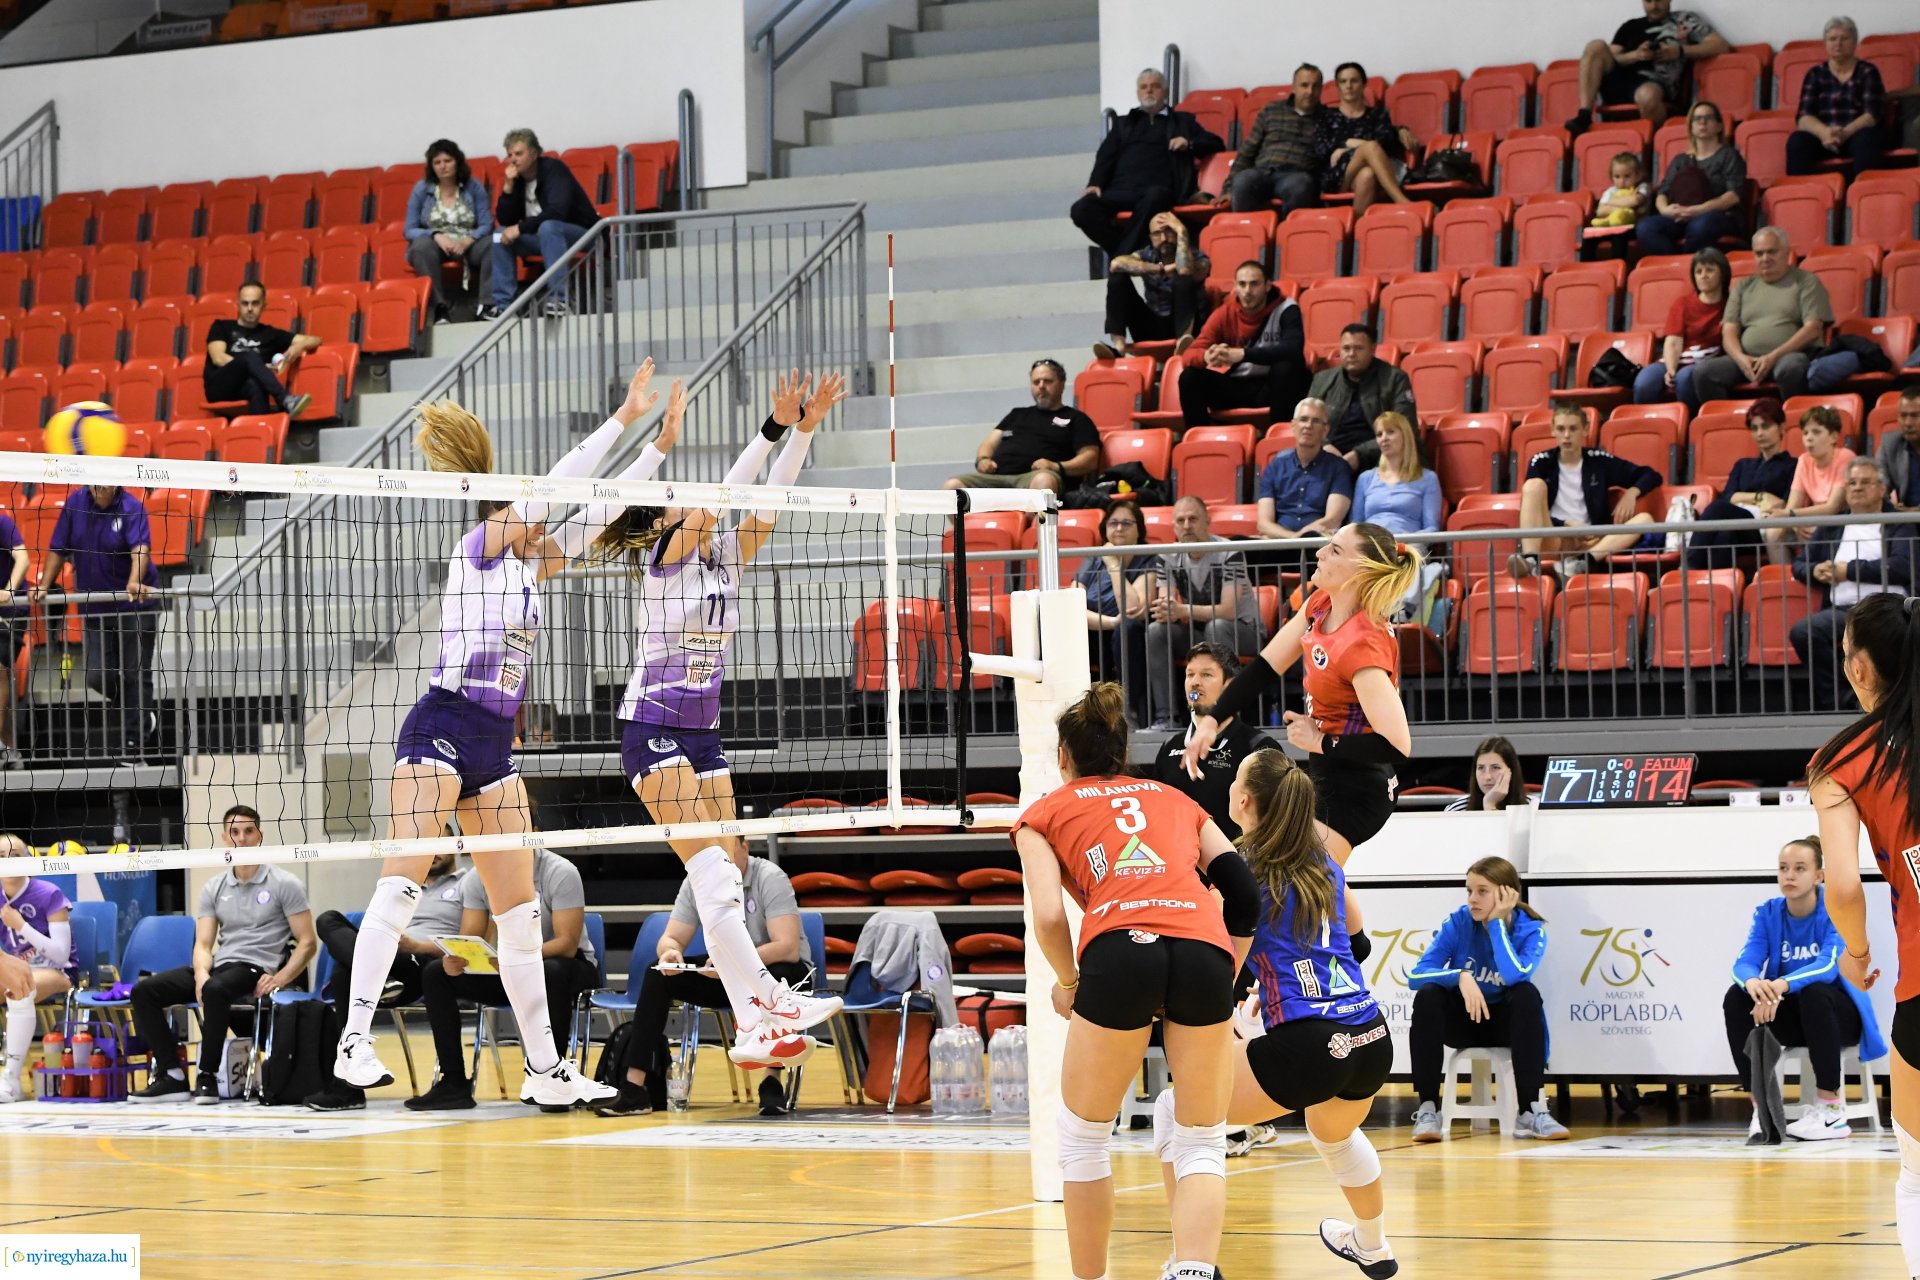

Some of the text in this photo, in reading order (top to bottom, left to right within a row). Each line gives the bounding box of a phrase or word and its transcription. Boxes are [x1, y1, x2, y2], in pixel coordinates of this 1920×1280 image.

[136, 464, 170, 480] FATUM
[378, 475, 408, 490] FATUM
[593, 483, 620, 499] FATUM
[786, 491, 811, 505] FATUM
[1549, 759, 1576, 771] UTE
[1644, 757, 1693, 770] FATUM
[1628, 771, 1637, 780] 0
[1075, 782, 1163, 799] MILANOVA
[1559, 773, 1582, 802] 7
[1644, 771, 1685, 801] 14
[1610, 790, 1620, 799] V
[1624, 790, 1633, 799] 0
[1111, 796, 1148, 835] 3
[522, 835, 545, 848] FATUM
[294, 847, 319, 860] FATUM
[43, 859, 70, 872] FATUM
[1119, 899, 1197, 911] BESTRONG
[1605, 991, 1645, 1000] MAGYAR
[1570, 1000, 1683, 1022] RÖPLABDA
[1600, 1025, 1652, 1036] SZÖVETSÉG
